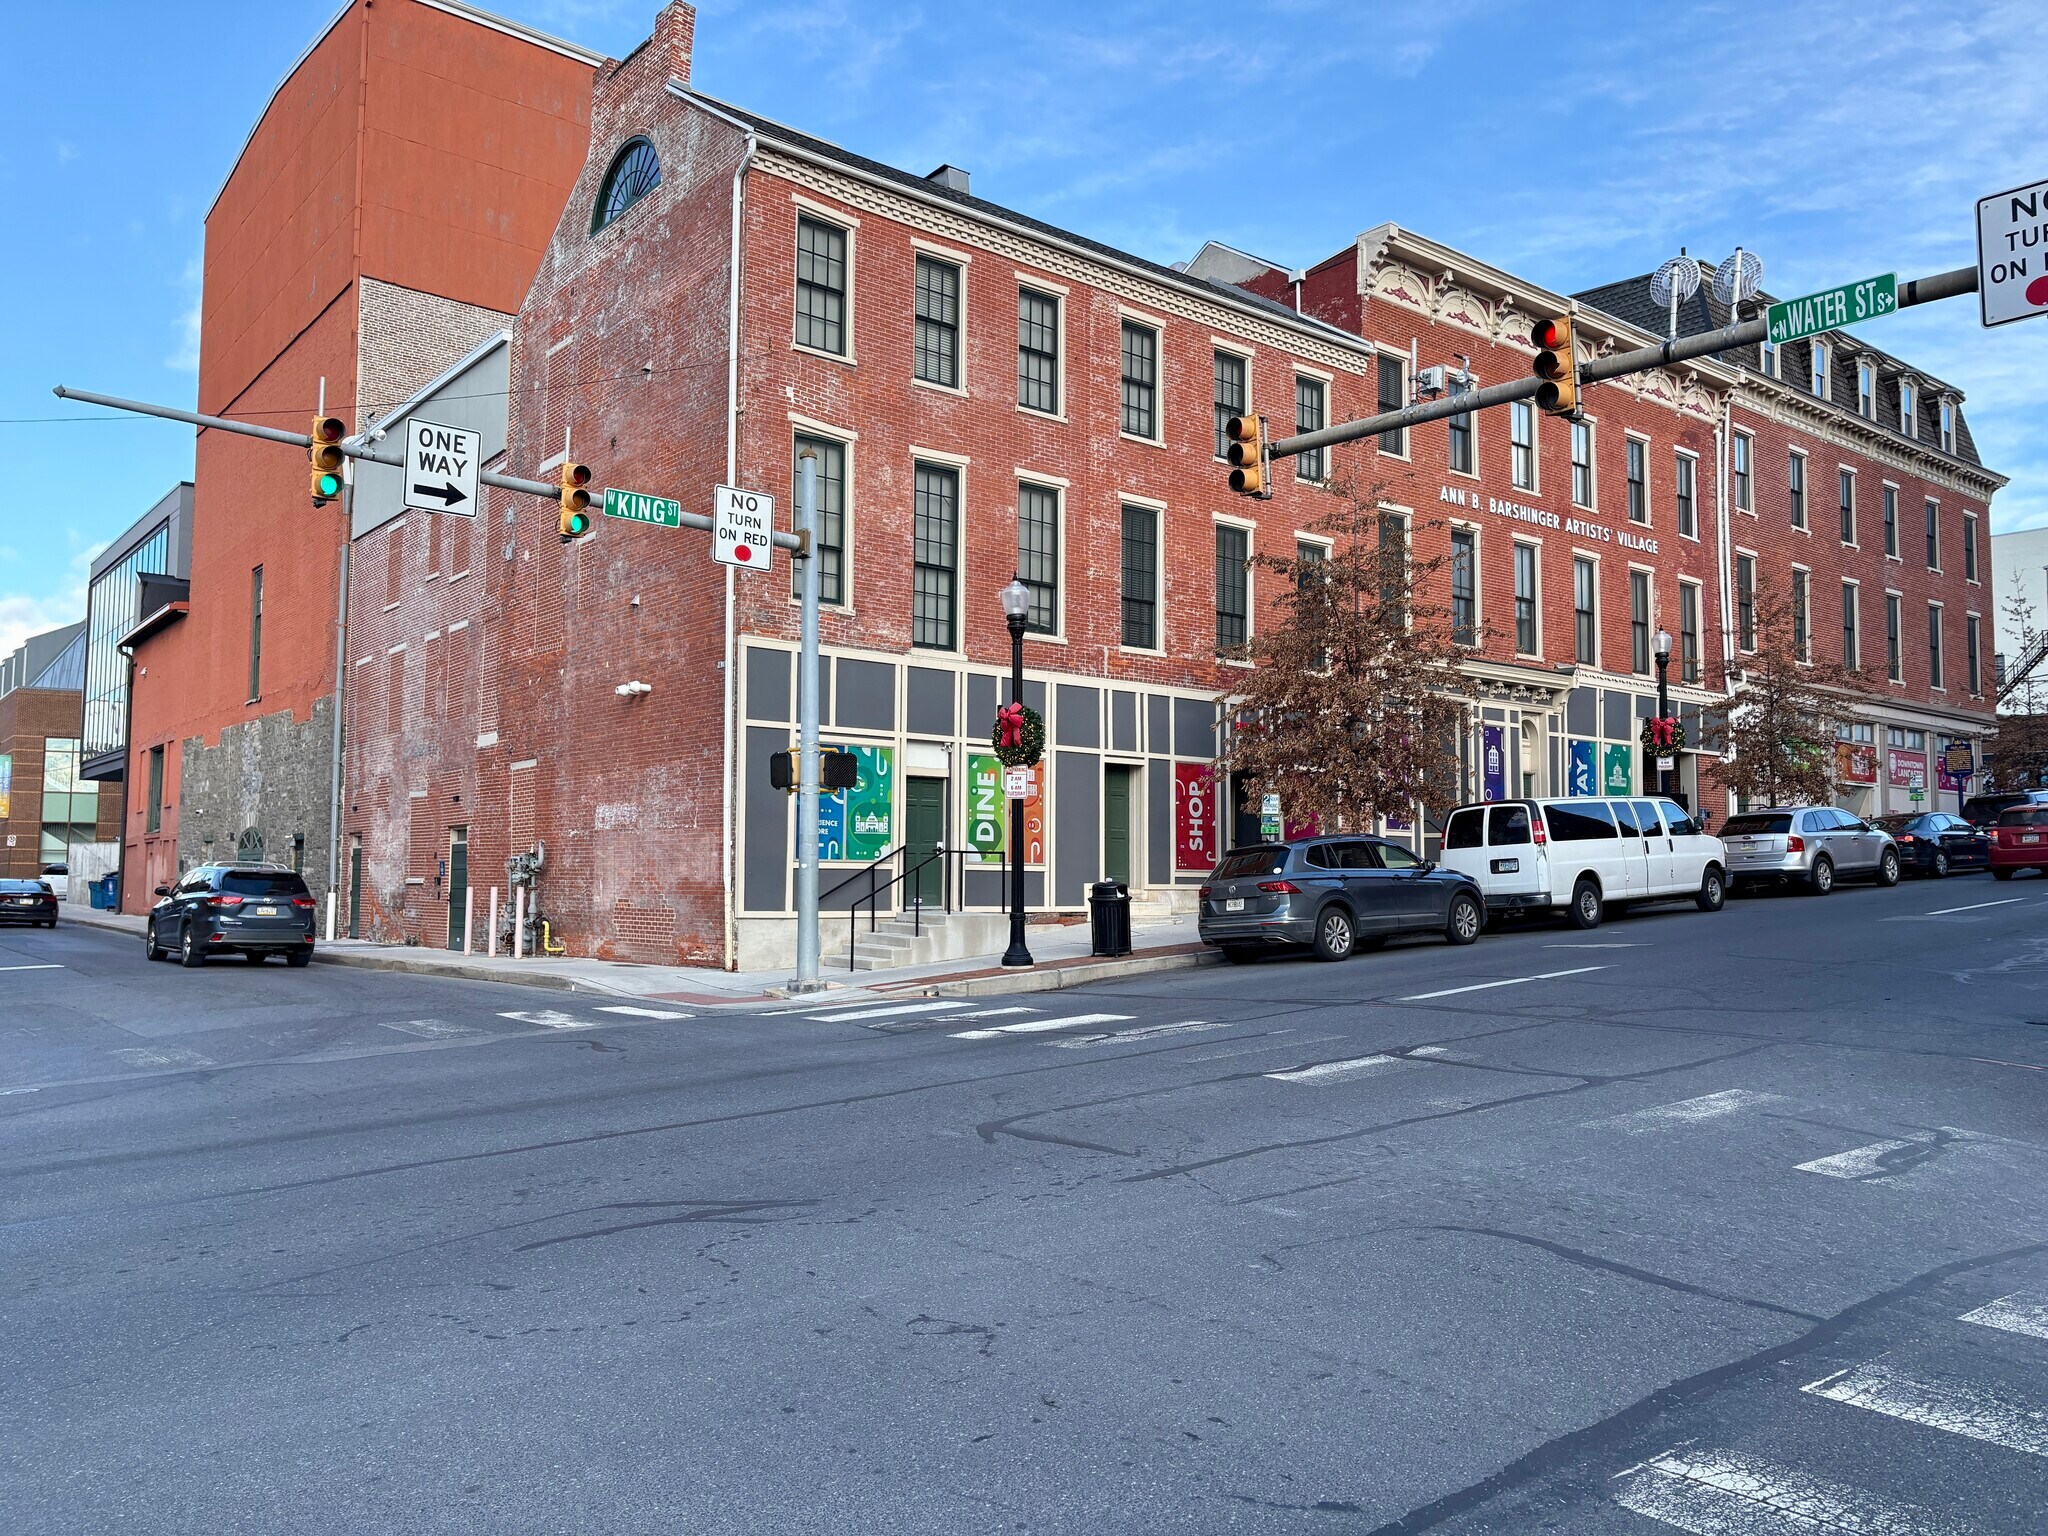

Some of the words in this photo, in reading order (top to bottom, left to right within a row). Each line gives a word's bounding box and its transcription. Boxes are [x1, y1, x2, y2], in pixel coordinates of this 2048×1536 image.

[2011, 190, 2048, 223] N
[1991, 257, 2027, 284] ON
[1779, 319, 1787, 340] N
[1787, 290, 1847, 336] WATER
[1855, 281, 1876, 318] ST
[1877, 292, 1885, 312] S
[419, 428, 466, 454] ONE
[419, 451, 468, 477] WAY
[607, 490, 616, 505] W
[617, 493, 665, 523] KING
[667, 502, 678, 517] ST
[731, 493, 758, 512] NO
[728, 512, 761, 529] TURN
[1440, 485, 1465, 506] ANN
[1472, 493, 1483, 510] B.
[1489, 497, 1560, 530] BARSHINGER
[1565, 518, 1613, 542] ARTISTS'
[1617, 531, 1658, 554] VILLAGE
[719, 527, 737, 541] ON
[744, 532, 768, 547] RED
[1576, 757, 1588, 797] TAY
[1898, 759, 1924, 770] DOWNTOWN
[976, 772, 995, 841] DINE
[1263, 794, 1270, 804] 2
[1189, 781, 1203, 851] SHOP
